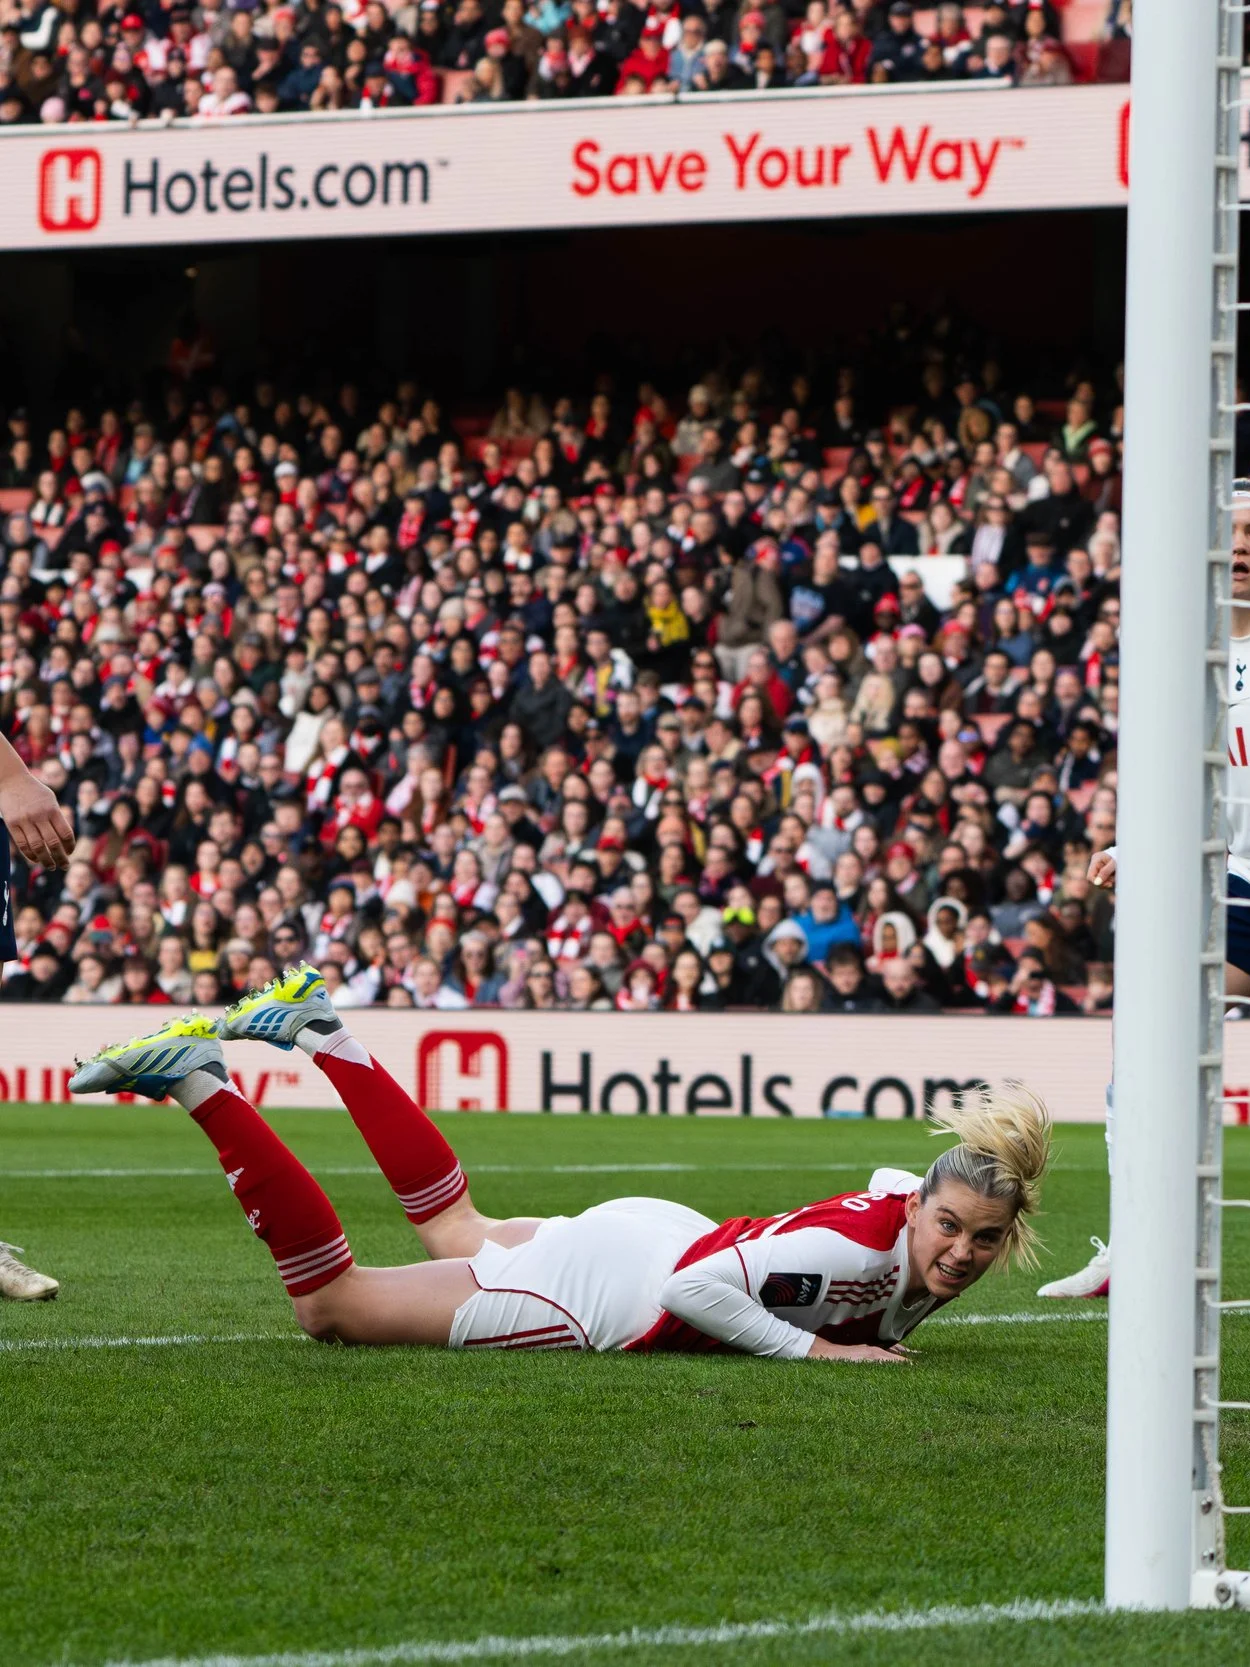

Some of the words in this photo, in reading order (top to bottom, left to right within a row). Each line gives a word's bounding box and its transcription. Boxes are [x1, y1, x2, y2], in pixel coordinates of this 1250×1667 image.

[122, 152, 430, 216] Hotels.com
[571, 139, 707, 197] Save
[723, 131, 852, 191] Your
[540, 1050, 996, 1119] Hotelscom
